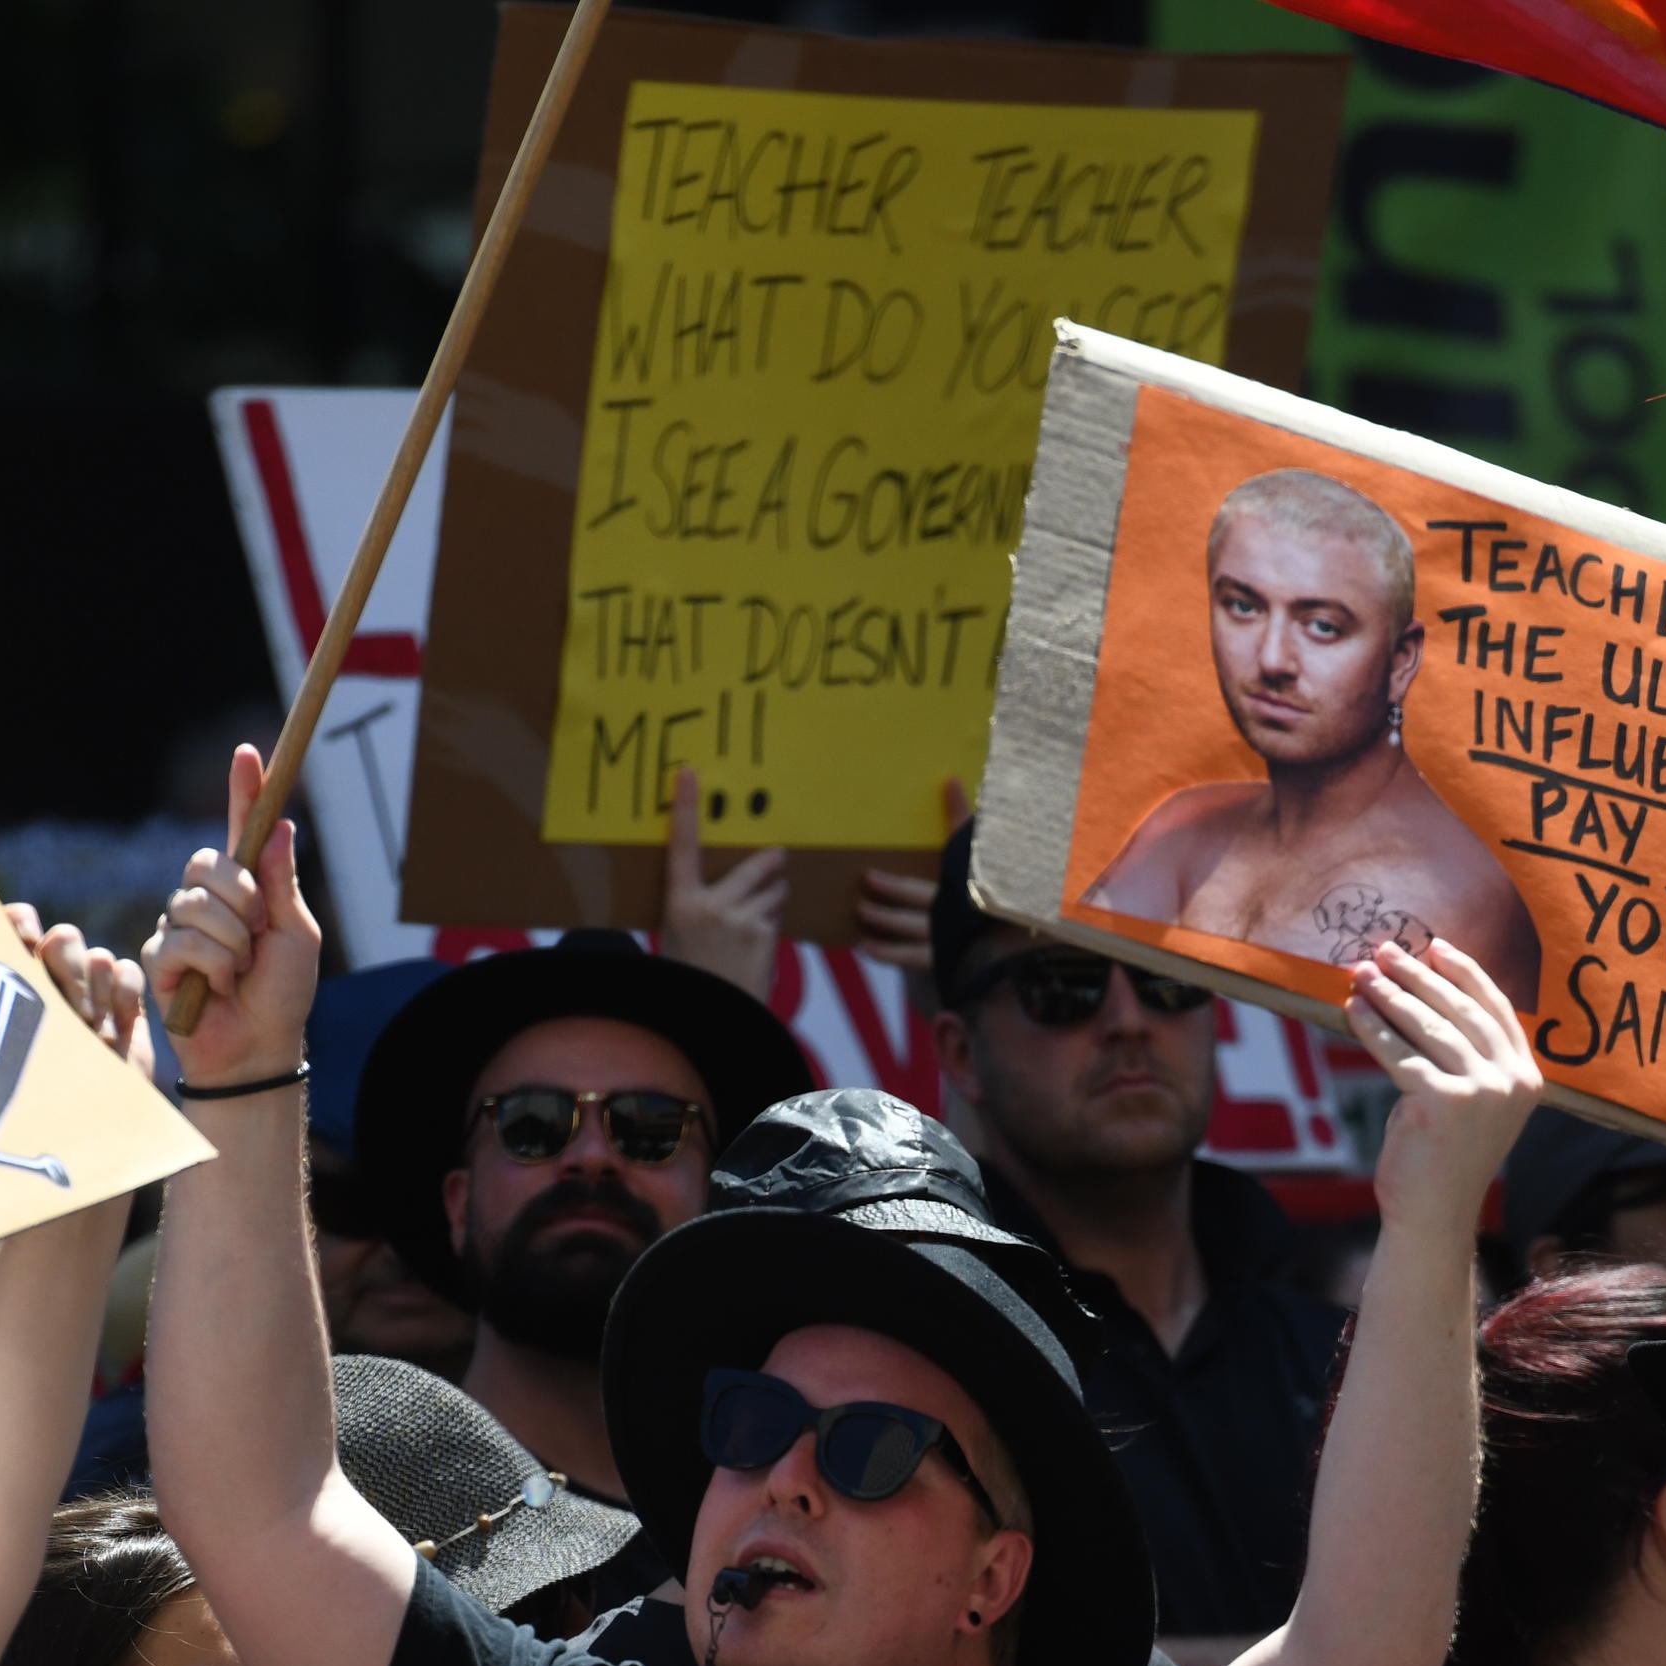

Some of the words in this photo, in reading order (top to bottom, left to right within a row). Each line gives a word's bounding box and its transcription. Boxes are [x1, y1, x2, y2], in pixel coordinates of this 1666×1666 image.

[635, 118, 923, 256] TEACHER
[971, 145, 1211, 258] TEACHER
[605, 262, 805, 384] WHAT
[811, 278, 925, 384] DO
[587, 398, 653, 532] I
[645, 418, 749, 540] SEE
[746, 436, 799, 550] A
[807, 436, 1031, 552] GOVERN
[581, 586, 723, 684] THAT
[739, 584, 985, 692] DOESN'T
[1438, 605, 1566, 683] THE
[1532, 780, 1648, 865] PAY
